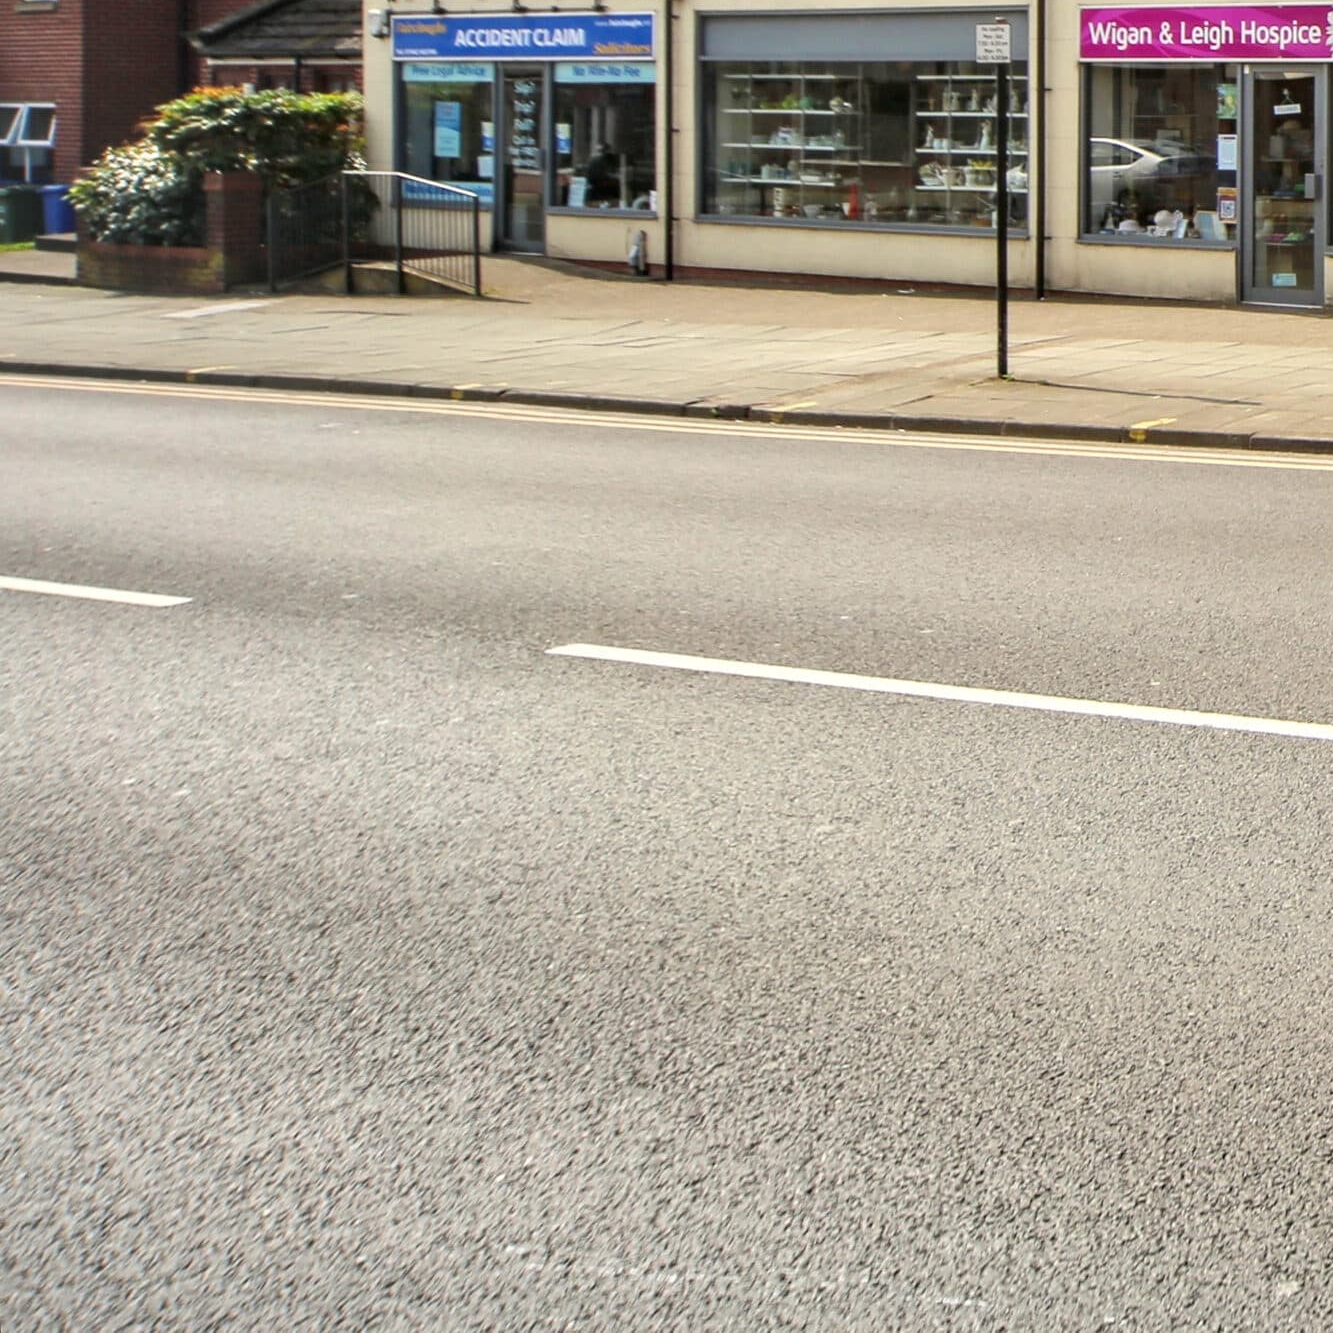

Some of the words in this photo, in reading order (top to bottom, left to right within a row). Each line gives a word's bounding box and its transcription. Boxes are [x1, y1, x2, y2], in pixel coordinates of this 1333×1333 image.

[454, 28, 532, 47] ACCIDENT
[532, 27, 586, 47] CLAIM
[1088, 21, 1152, 51] Wigan
[1159, 21, 1174, 45] &
[1180, 20, 1234, 50] Leigh
[1240, 19, 1321, 50] Hospice
